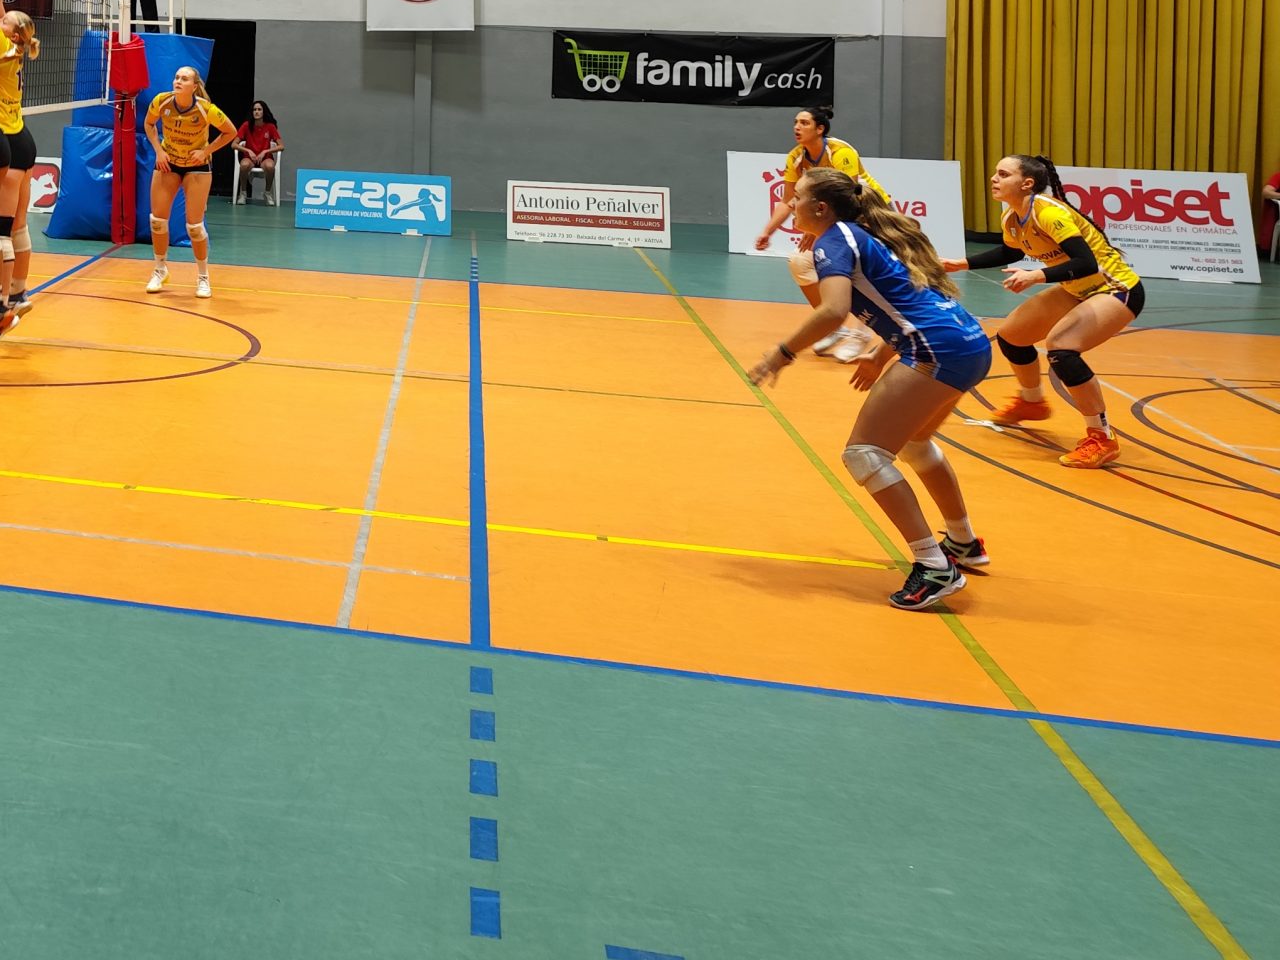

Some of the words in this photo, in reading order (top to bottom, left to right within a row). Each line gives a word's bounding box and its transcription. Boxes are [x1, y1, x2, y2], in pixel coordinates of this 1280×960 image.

[636, 52, 762, 96] family
[764, 67, 822, 89] cash
[303, 179, 385, 209] SF-2
[516, 194, 580, 210] Antonio
[586, 195, 659, 215] Peñalver
[301, 208, 327, 216] SUPERLIGA
[545, 215, 571, 223] LABORAL
[599, 218, 628, 226] CONTABLE
[633, 220, 661, 228] SEGUROS
[1108, 223, 1172, 233] PROFESIONALES
[1170, 264, 1244, 274] www.copiset.es
